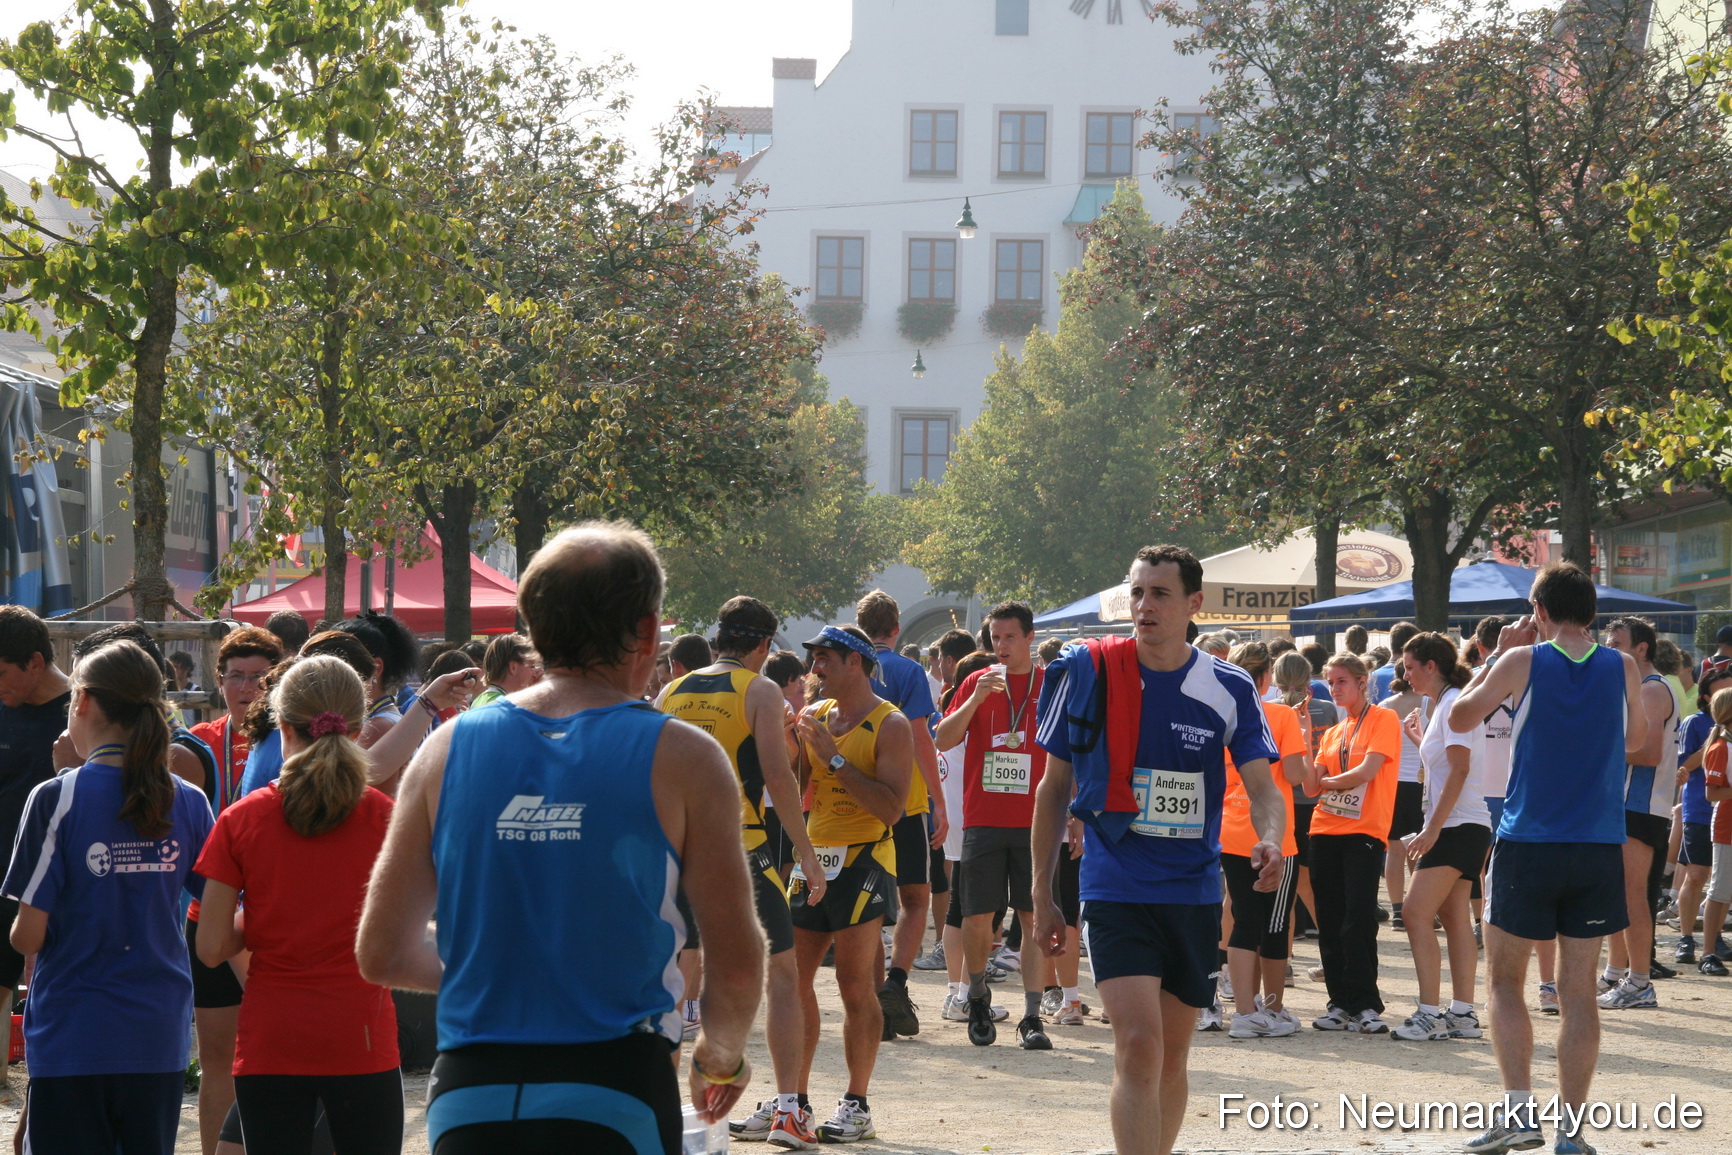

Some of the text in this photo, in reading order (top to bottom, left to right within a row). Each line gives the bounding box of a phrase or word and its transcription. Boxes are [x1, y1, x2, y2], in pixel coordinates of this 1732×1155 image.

[1177, 724, 1215, 738] INTERSPORT
[1181, 732, 1206, 744] KOLB
[995, 755, 1018, 764] Markus
[995, 767, 1026, 781] 5090
[1155, 775, 1196, 791] Andreas
[1136, 792, 1141, 801] A
[1154, 795, 1199, 815] 3391
[514, 807, 584, 822] NAGEL
[496, 829, 581, 842] TSG 08 Roth
